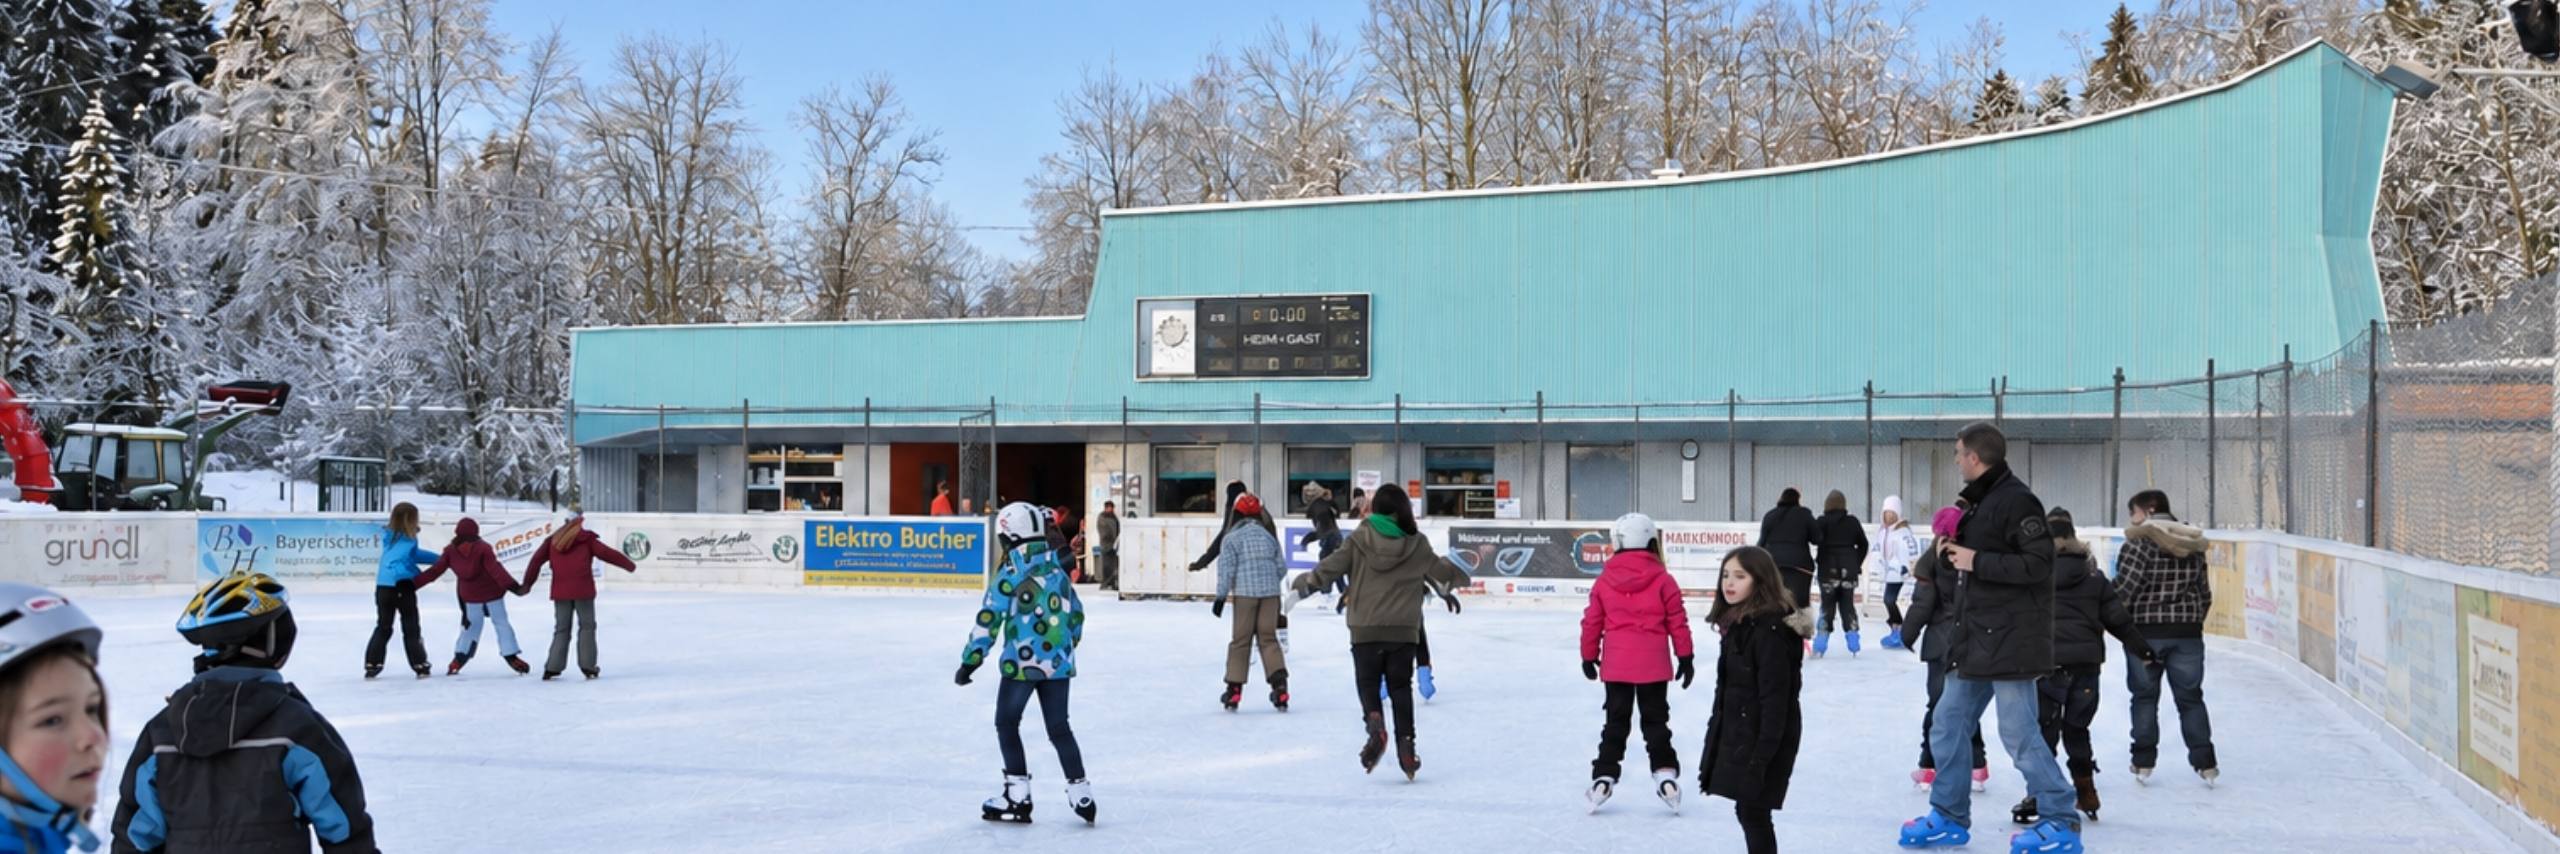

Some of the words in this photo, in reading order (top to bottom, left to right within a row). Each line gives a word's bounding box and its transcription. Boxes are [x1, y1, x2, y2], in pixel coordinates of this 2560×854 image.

[1286, 332, 1321, 345] GAST
[44, 524, 139, 567] grundl
[275, 532, 369, 552] Bayerischer
[815, 524, 893, 549] Elektro
[900, 526, 977, 550] Bucher
